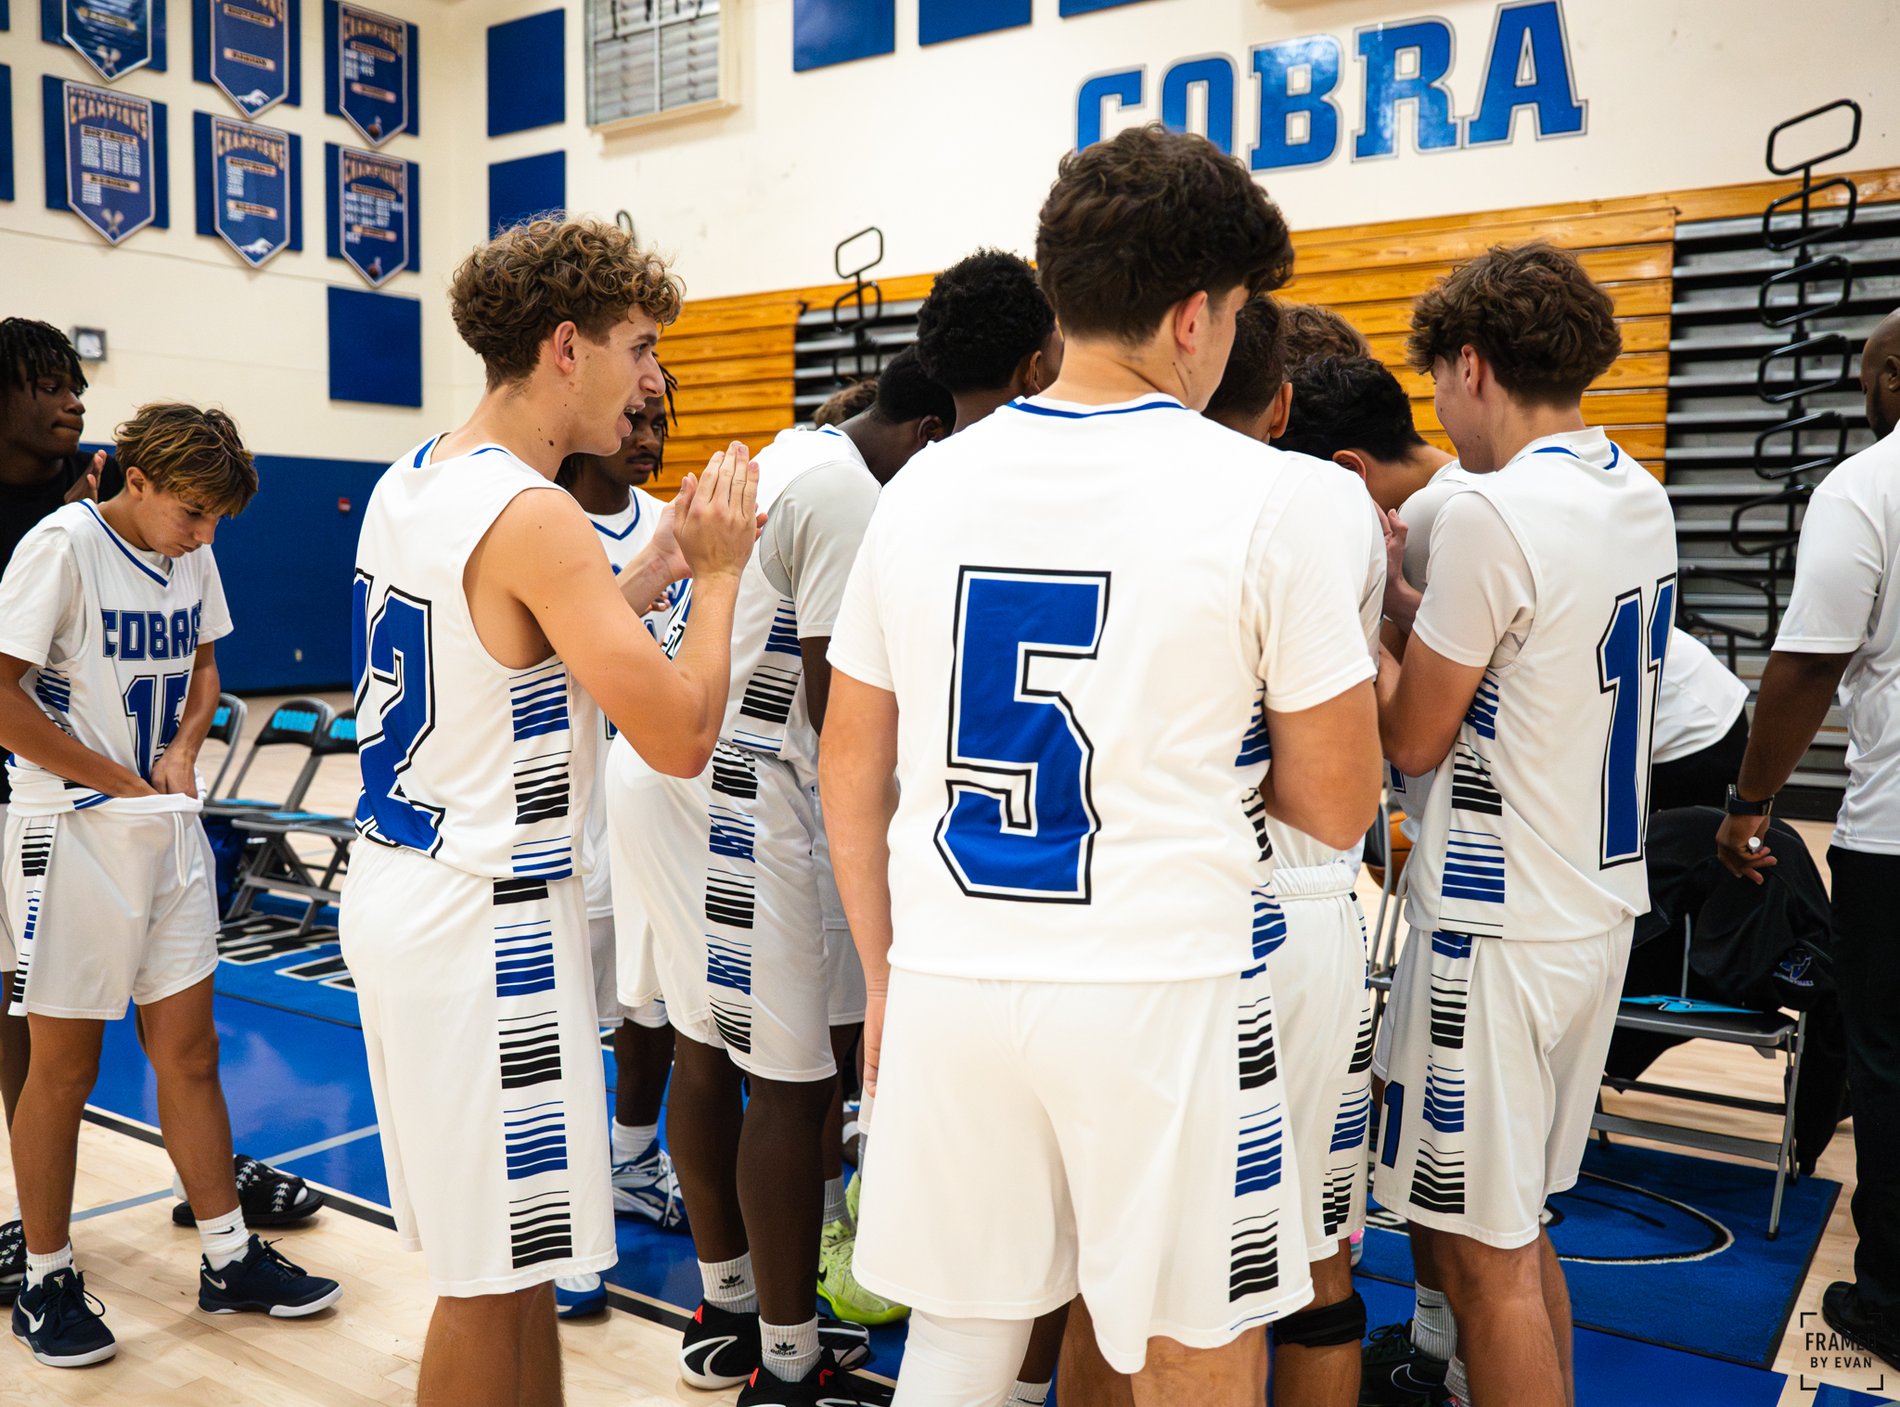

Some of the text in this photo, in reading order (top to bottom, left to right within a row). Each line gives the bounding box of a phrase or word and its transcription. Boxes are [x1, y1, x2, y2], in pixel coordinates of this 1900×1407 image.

[1074, 0, 1589, 173] COBRA
[932, 565, 1112, 905] 5
[1596, 572, 1677, 871] 11
